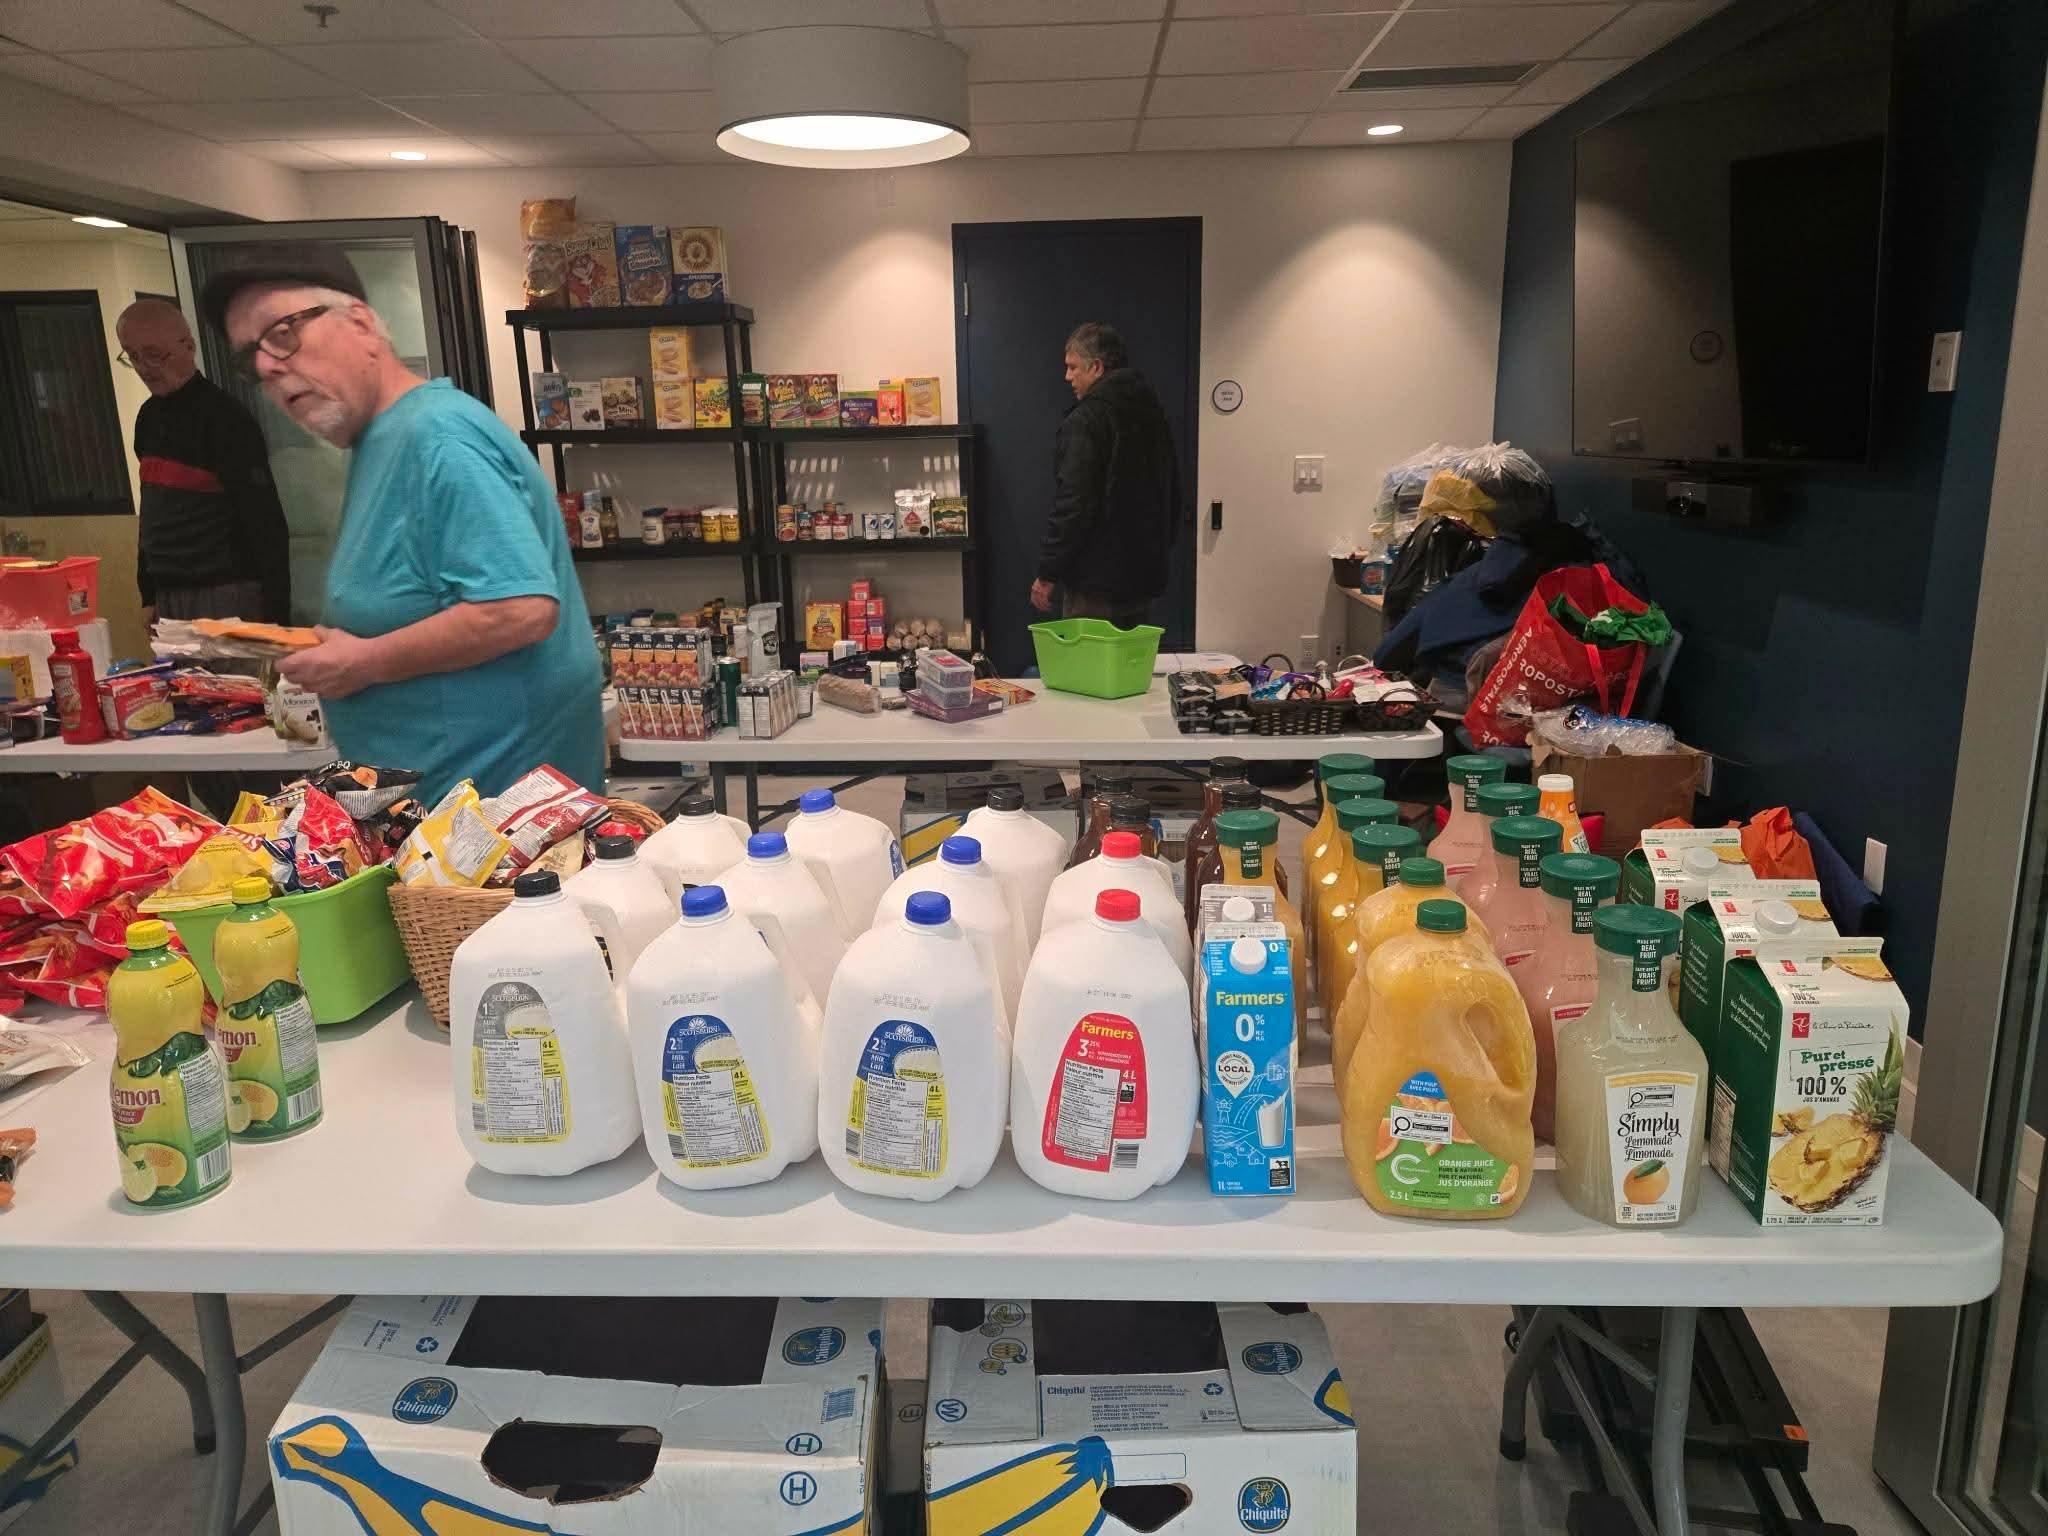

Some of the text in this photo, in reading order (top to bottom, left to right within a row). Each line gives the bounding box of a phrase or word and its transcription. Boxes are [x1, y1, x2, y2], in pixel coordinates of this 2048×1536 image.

[1216, 991, 1284, 1006] Farmers
[680, 1026, 718, 1036] SCOTSBURN
[884, 1032, 924, 1044] SCOTSBURN
[1082, 1021, 1134, 1041] Farmers
[1800, 1050, 1846, 1064] Pur et
[1218, 1065, 1251, 1073] LOCAL
[1820, 1056, 1875, 1076] pressé
[1617, 1112, 1682, 1138] Simply
[1624, 1135, 1673, 1149] Lemonade
[1624, 1148, 1671, 1162] Limonade
[1454, 1179, 1494, 1187] D'ORANGE
[1390, 1190, 1402, 1199] 2.5
[815, 1327, 834, 1363] Chiquita
[1047, 1387, 1085, 1396] Chiquita
[394, 1400, 448, 1416] Chiquita
[794, 1438, 813, 1452] H
[789, 1477, 807, 1499] H
[1240, 1507, 1288, 1524] Chiquita
